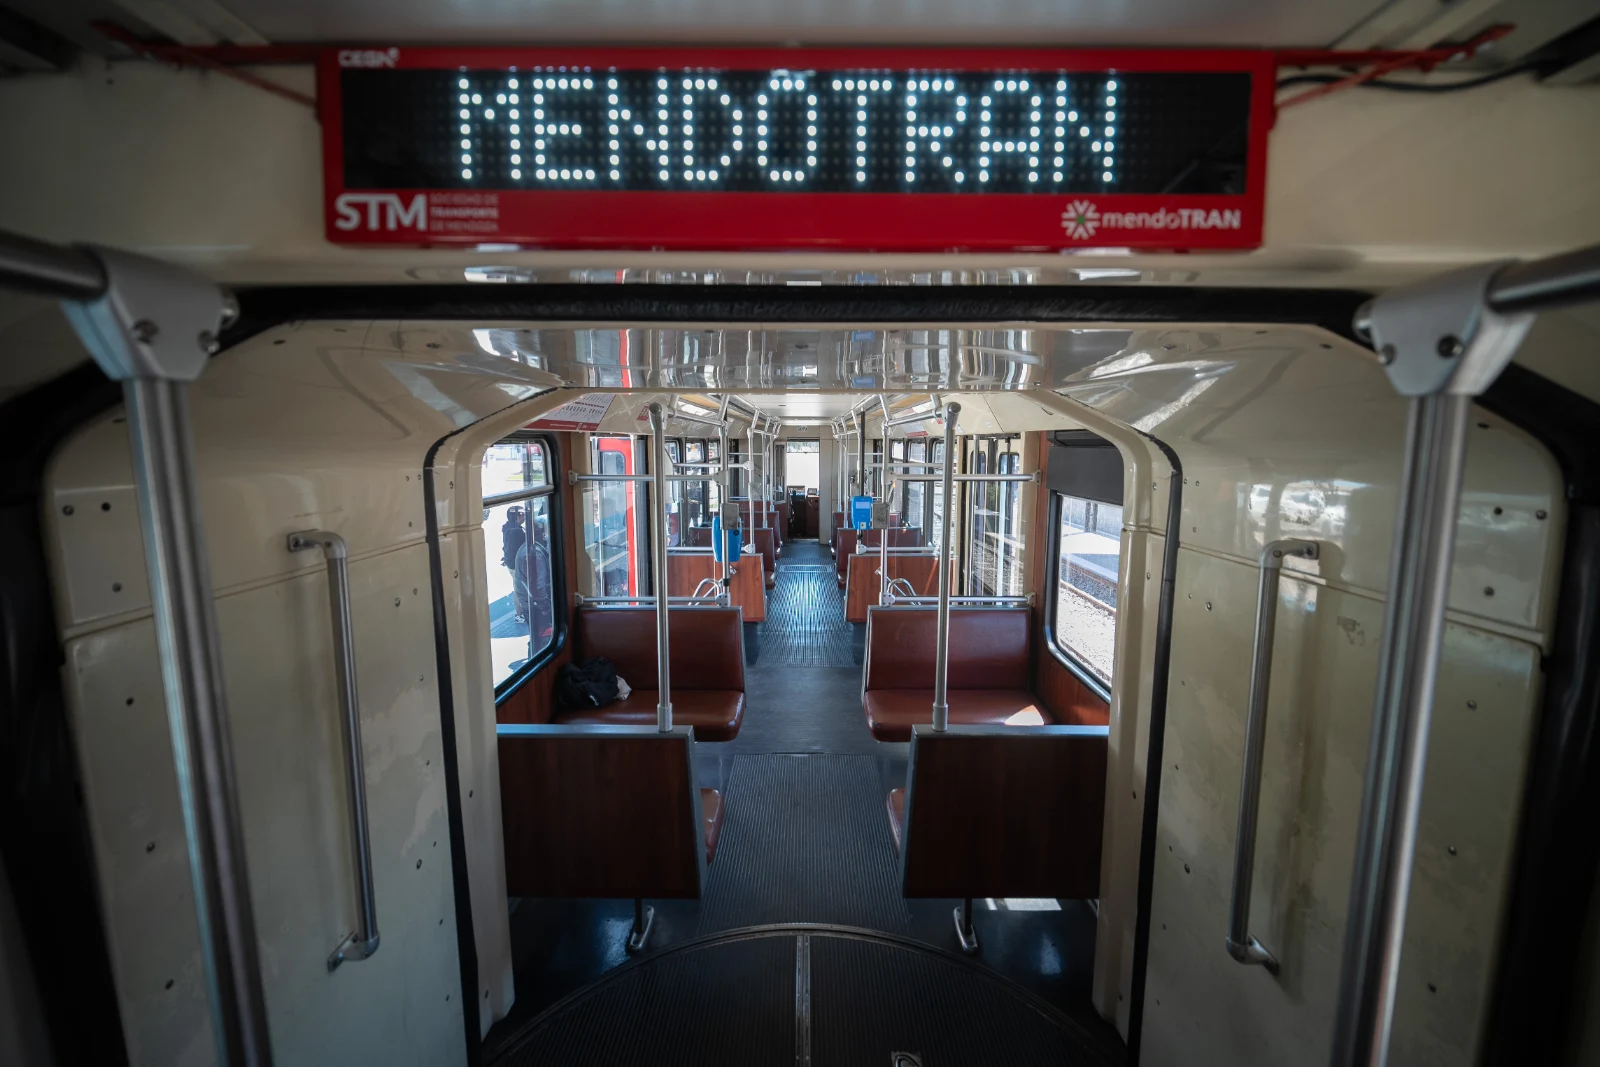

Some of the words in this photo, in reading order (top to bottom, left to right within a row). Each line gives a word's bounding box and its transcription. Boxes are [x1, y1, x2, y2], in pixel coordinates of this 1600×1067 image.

[457, 77, 1118, 184] MENDOTRAN
[335, 193, 427, 231] STM
[430, 206, 498, 219] TRANSPORTE
[1101, 207, 1242, 230] mendoTRAN
